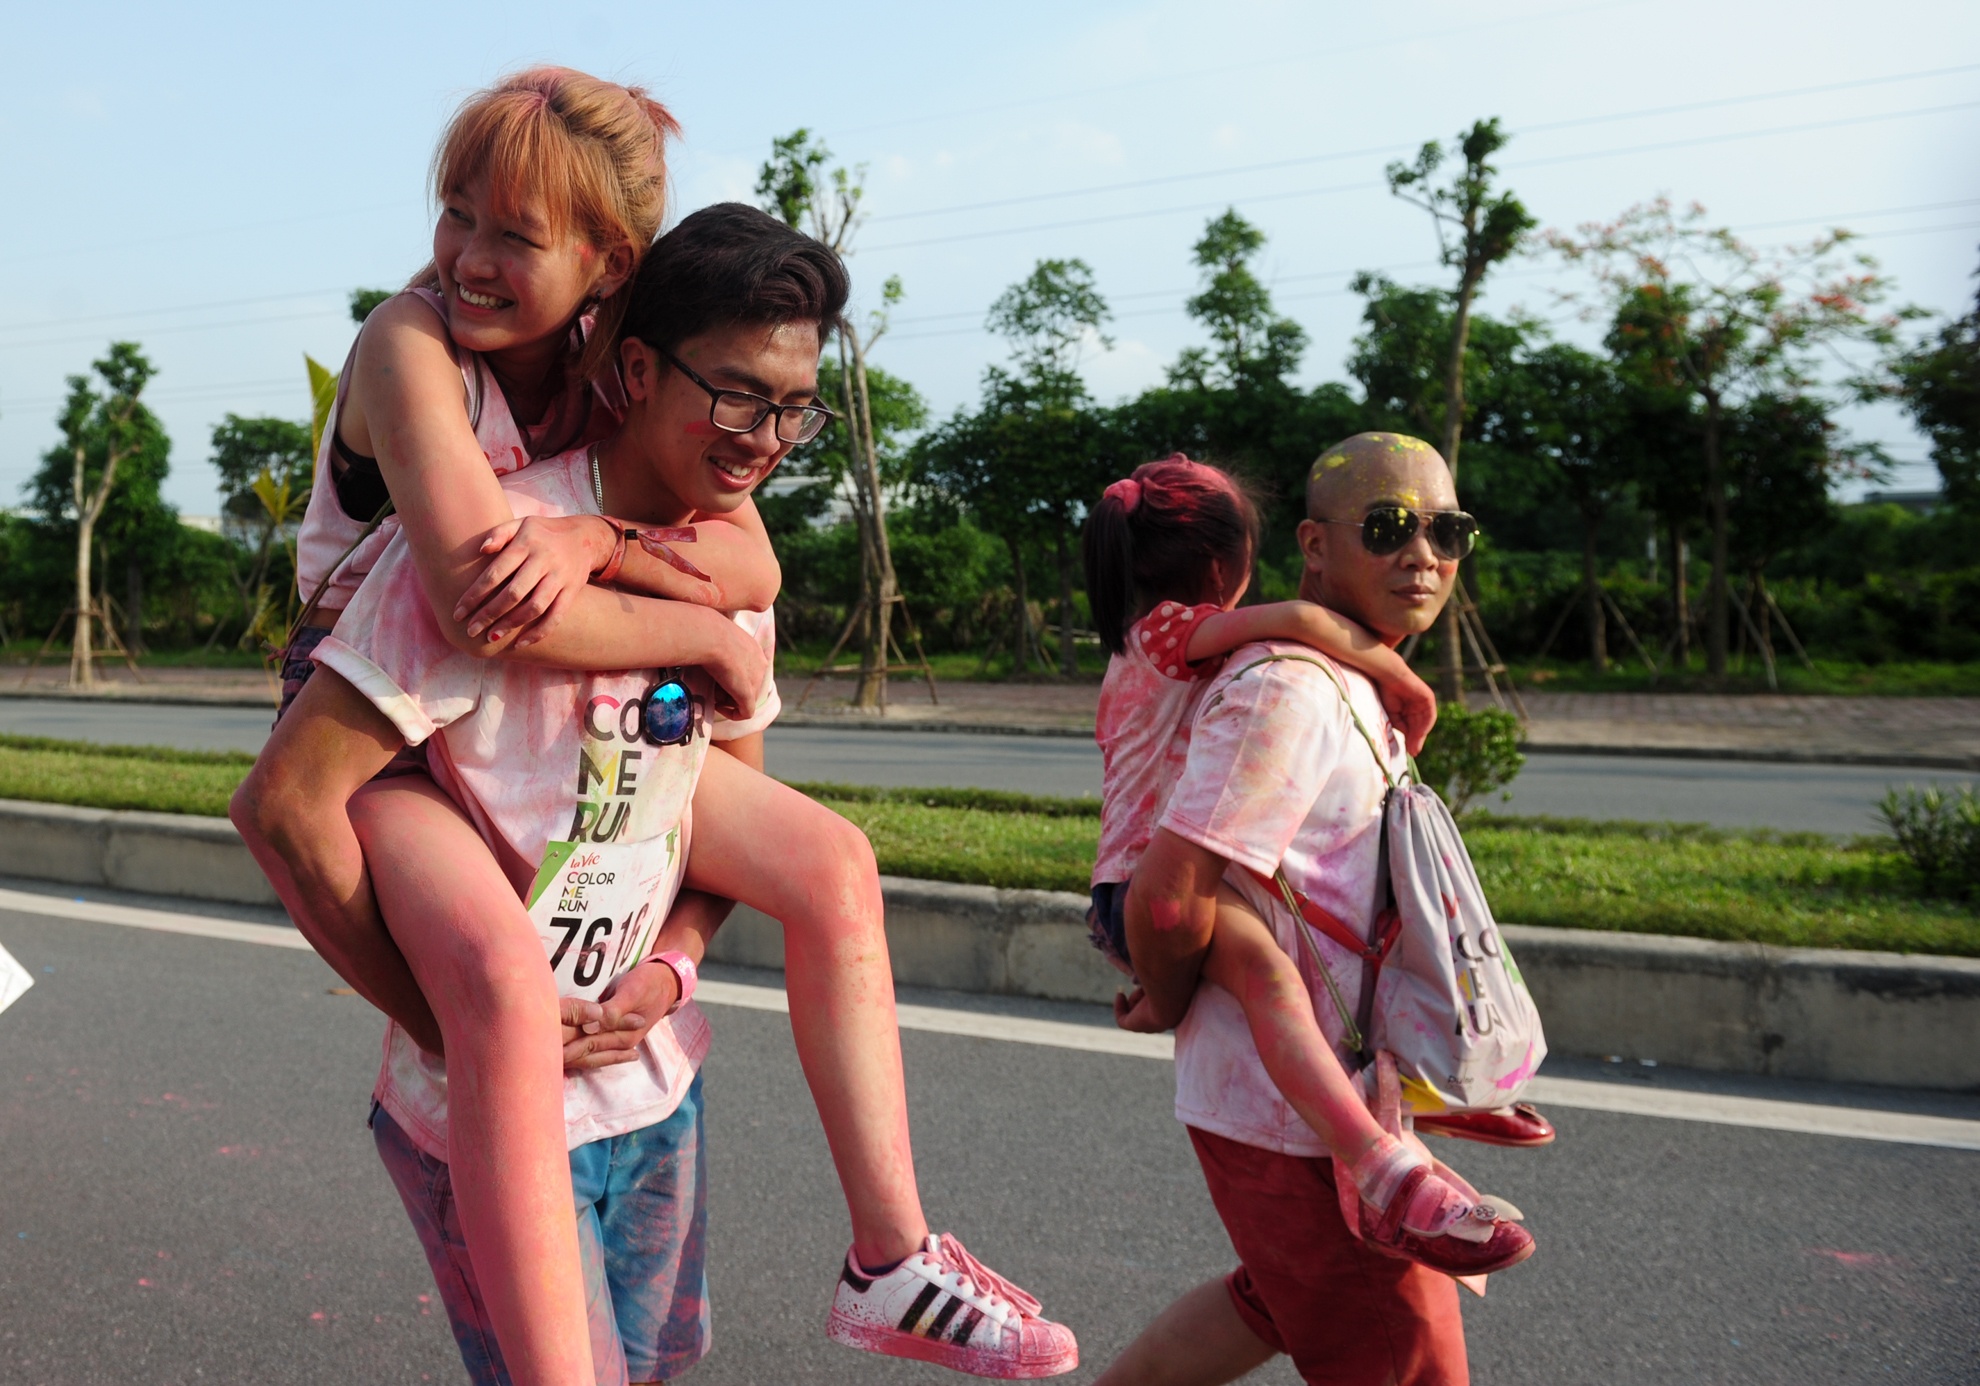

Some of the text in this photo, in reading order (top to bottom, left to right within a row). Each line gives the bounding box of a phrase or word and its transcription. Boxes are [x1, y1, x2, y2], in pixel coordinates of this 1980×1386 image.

[583, 694, 705, 743] COR
[577, 747, 642, 796] ME
[561, 886, 586, 899] ME
[567, 871, 616, 885] COLOR
[557, 899, 589, 912] RUN
[549, 902, 649, 987] 7616
